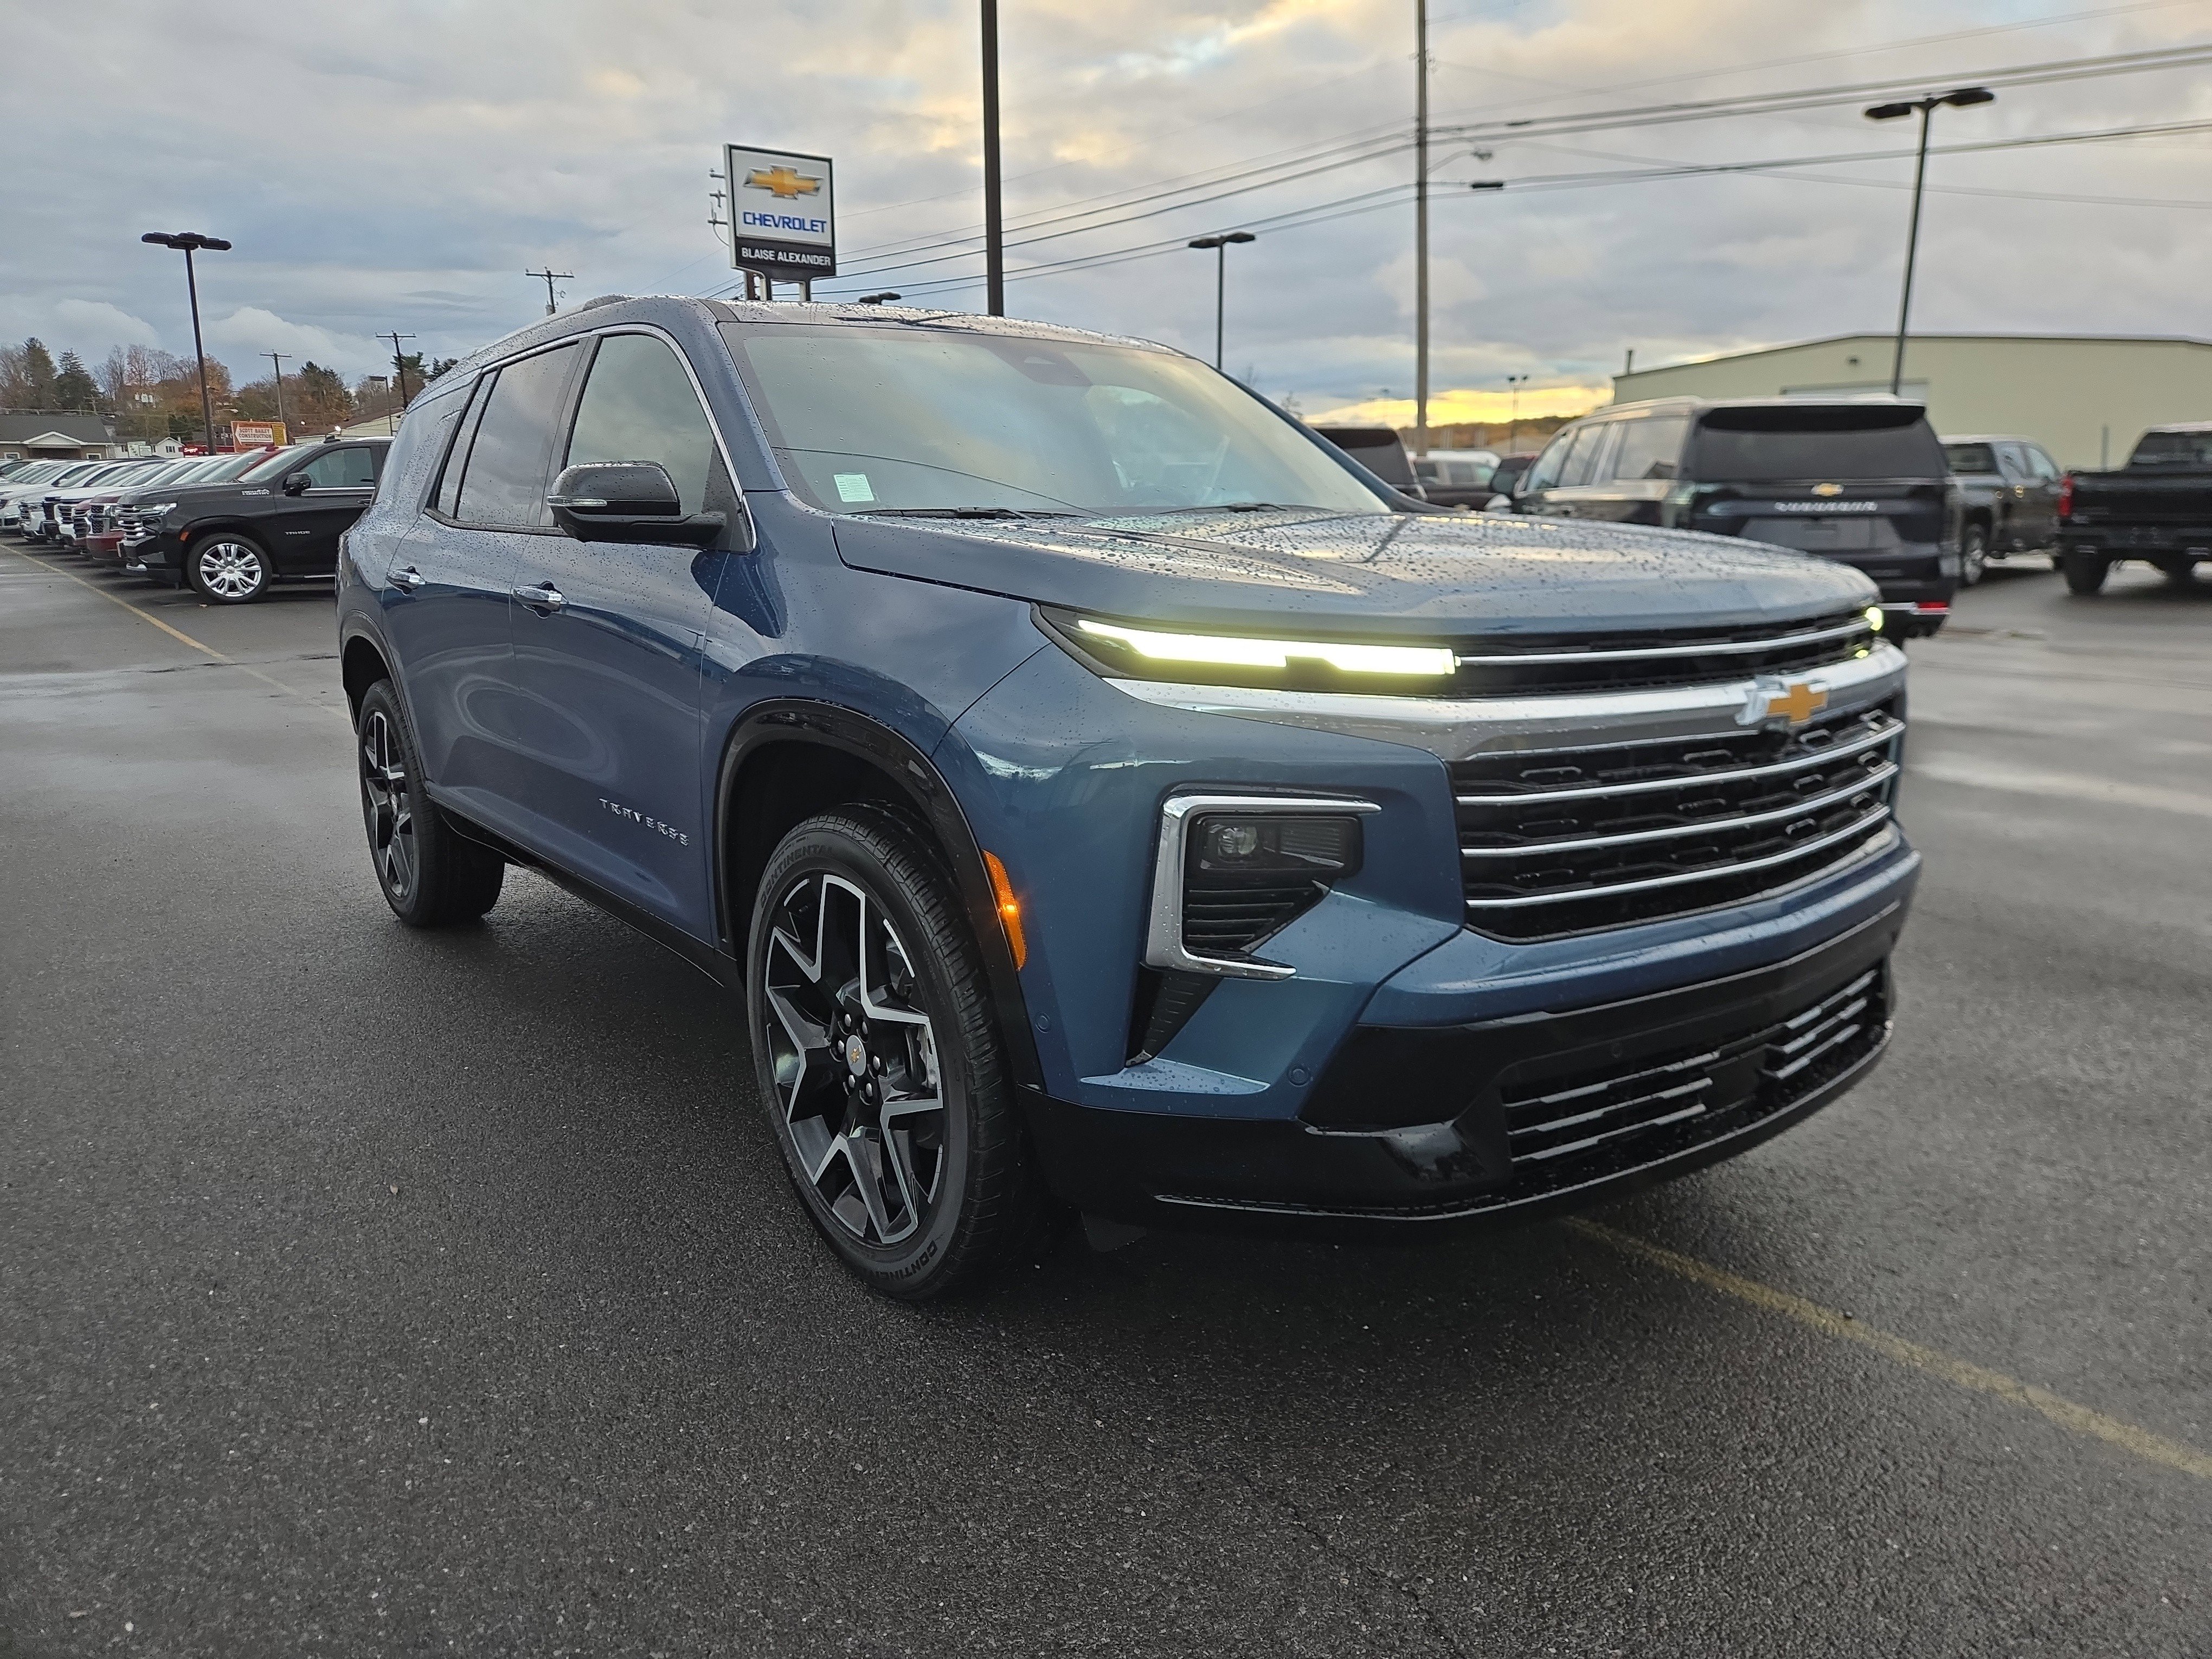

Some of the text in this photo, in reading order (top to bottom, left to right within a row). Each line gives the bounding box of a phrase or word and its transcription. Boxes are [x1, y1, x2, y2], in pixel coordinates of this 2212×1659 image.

[743, 211, 827, 233] CHEVROLET
[741, 247, 831, 267] BLAISE ALEXANDER
[599, 798, 689, 846] TRAVERSE
